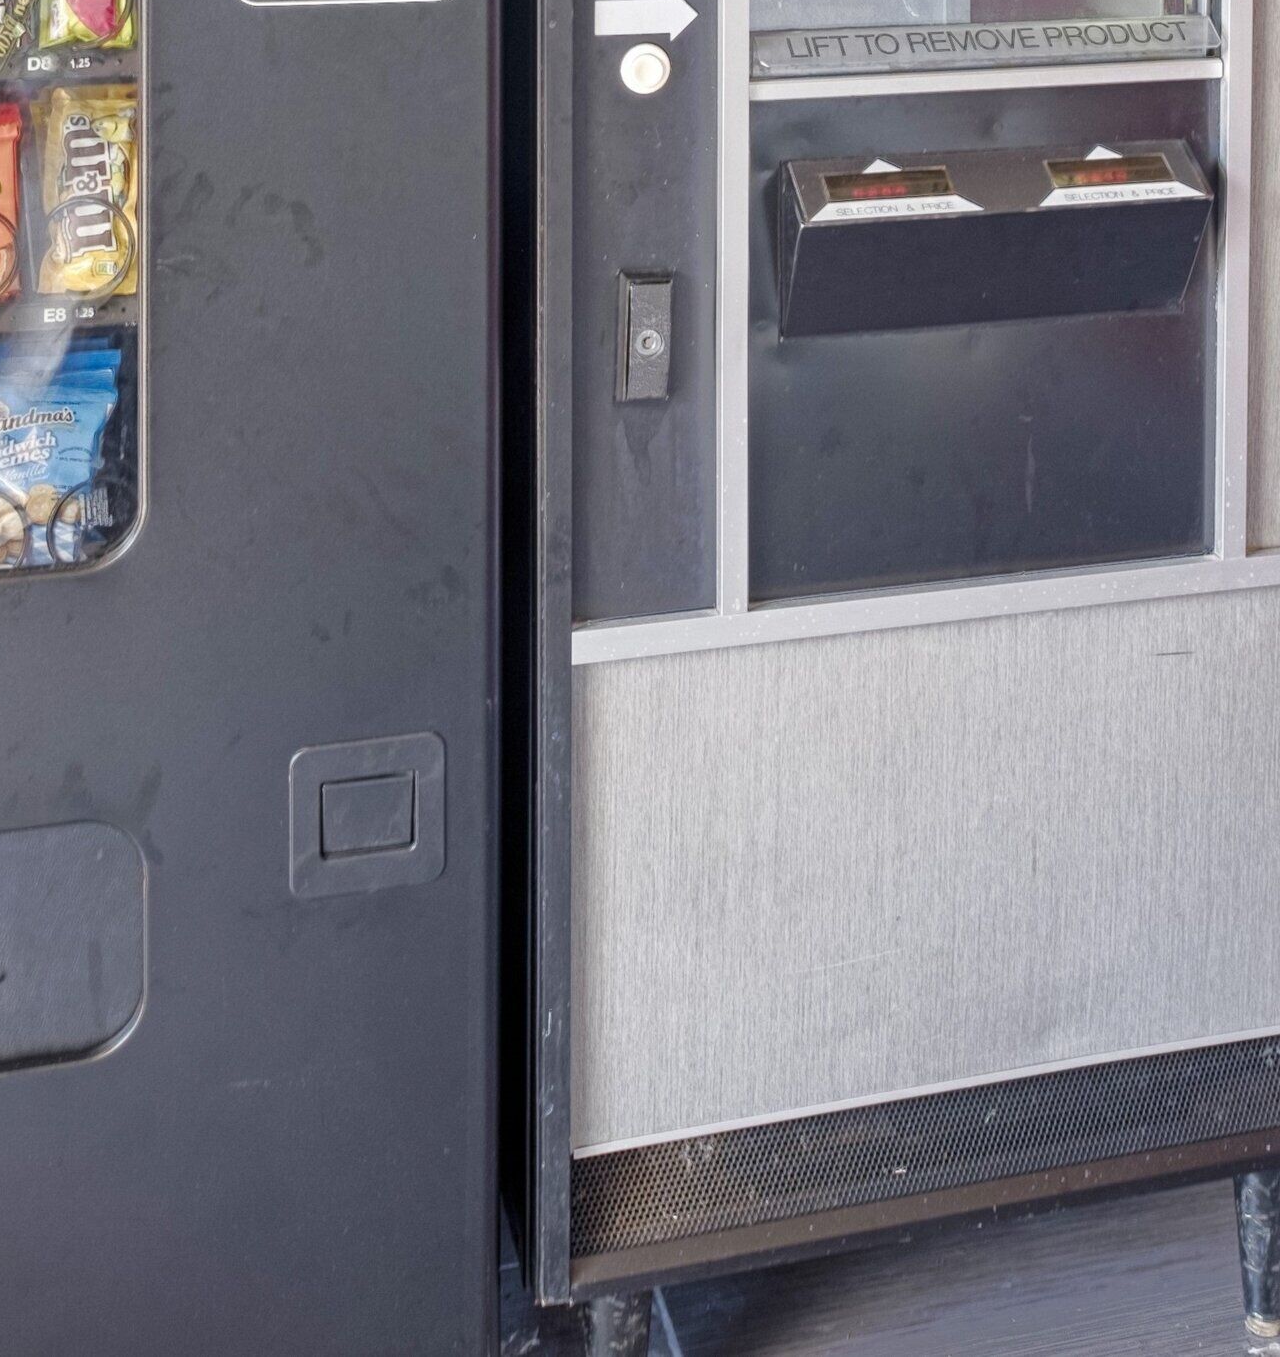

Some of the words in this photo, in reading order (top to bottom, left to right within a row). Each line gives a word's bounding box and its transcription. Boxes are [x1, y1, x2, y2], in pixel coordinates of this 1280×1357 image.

[786, 35, 849, 59] LIFT
[865, 32, 900, 56] TO
[906, 27, 1040, 55] REMOVE
[1042, 21, 1188, 49] PRODUCT
[27, 57, 52, 71] D8
[835, 204, 899, 217] SELECTION
[906, 203, 915, 212] &
[921, 201, 954, 211] PRICE
